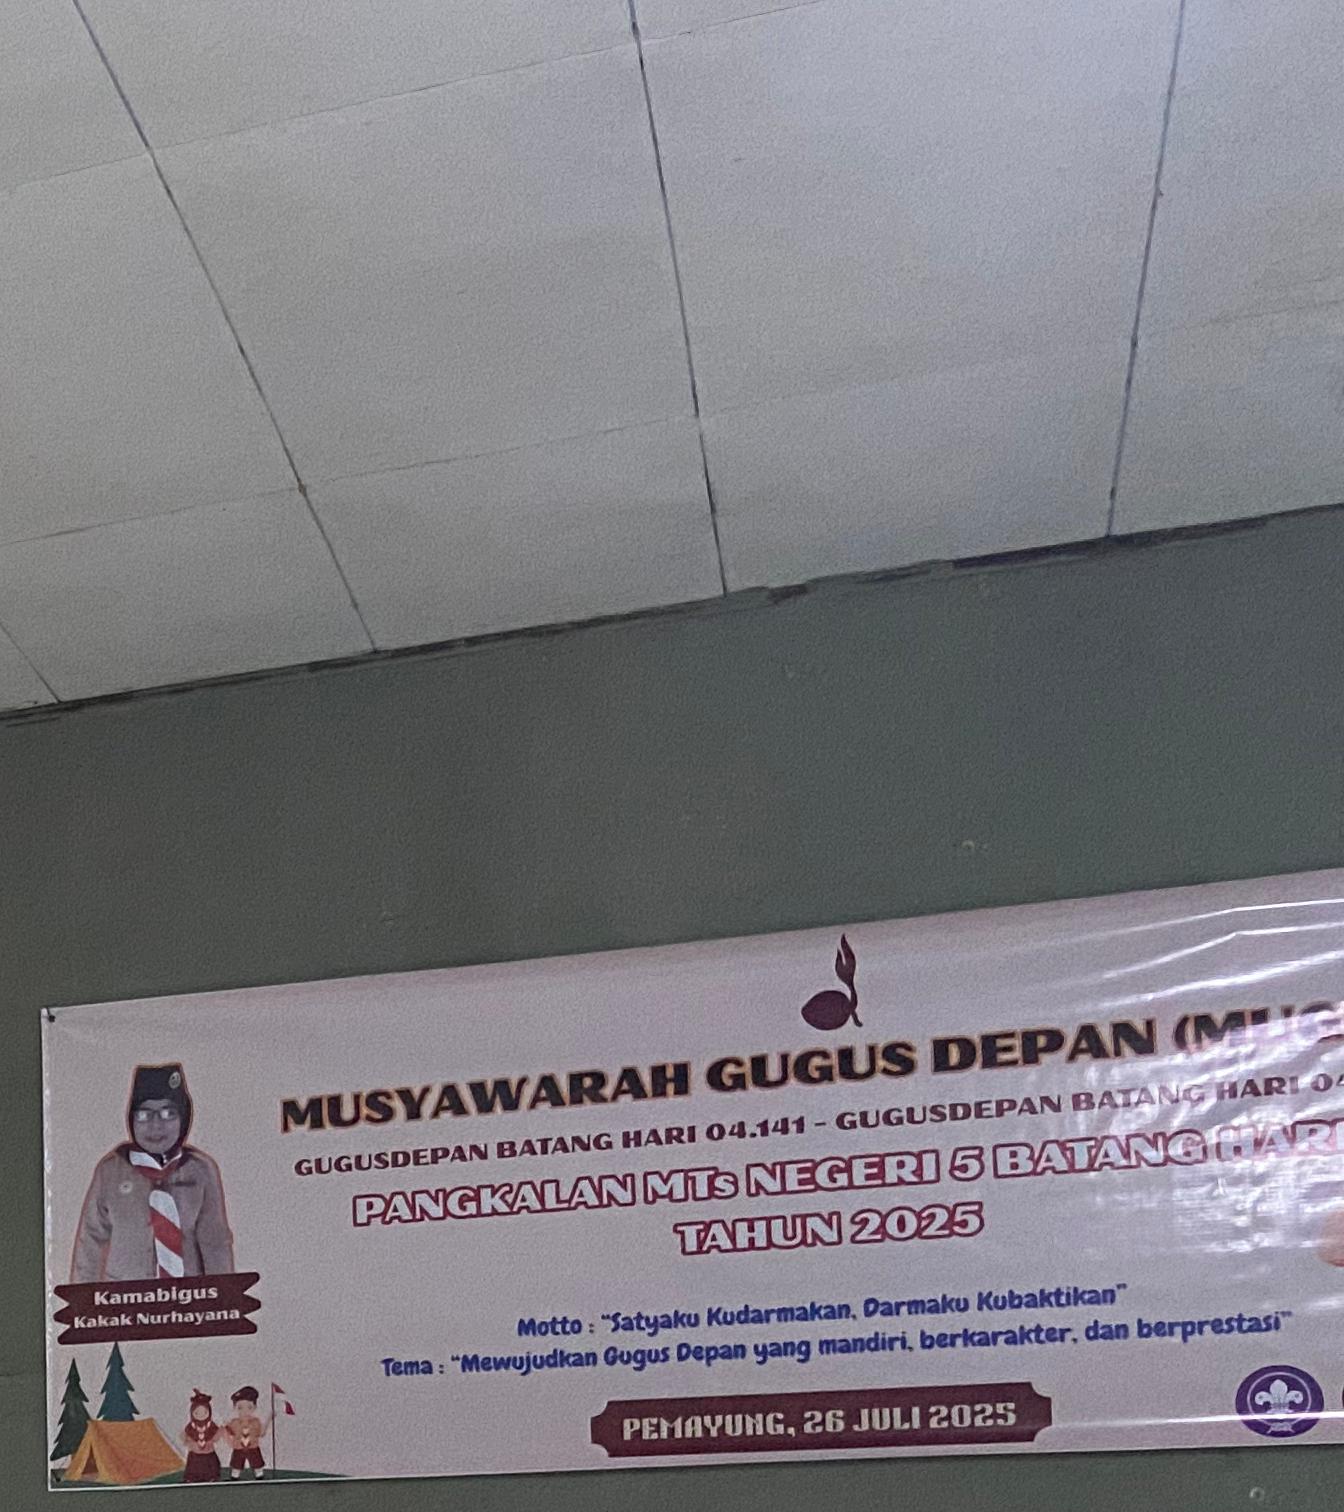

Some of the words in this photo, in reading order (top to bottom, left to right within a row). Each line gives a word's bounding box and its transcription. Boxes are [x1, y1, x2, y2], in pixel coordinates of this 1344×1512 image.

[281, 1061, 691, 1134] MUSYAWARAH
[706, 1040, 917, 1093] GUGUS
[930, 1018, 1156, 1074] DEPAN
[294, 1143, 488, 1177] GUGUSDEPAN
[497, 1132, 613, 1160] BATANG
[622, 1124, 696, 1149] HARI
[705, 1116, 805, 1141] 04.141
[835, 1094, 1061, 1131] GUGUSDEPAN
[1072, 1084, 1205, 1113] BATANG
[1216, 1076, 1299, 1100] HARI
[353, 1172, 635, 1227] PANGKALAN
[643, 1166, 739, 1206] MTs
[746, 1149, 940, 1197] NEGERI
[949, 1146, 985, 1181] 5
[993, 1127, 1209, 1179] BATANG
[673, 1211, 842, 1255] TAHUN
[850, 1201, 985, 1244] 2025
[74, 1311, 132, 1329] Kakak
[137, 1309, 240, 1326] Nurhayana
[94, 1287, 218, 1305] Kamabigus
[517, 1316, 582, 1337] Motto
[863, 1294, 969, 1318] Darmaku
[381, 1357, 433, 1377] Tema
[603, 1344, 670, 1371] Gugus
[676, 1342, 746, 1366] Depan
[753, 1337, 811, 1364] yang
[1085, 1319, 1129, 1341] dan
[623, 1412, 795, 1441] PEMAYUNG,
[804, 1409, 844, 1433] 26
[853, 1405, 920, 1432] JULI
[929, 1402, 1016, 1429] 2025
